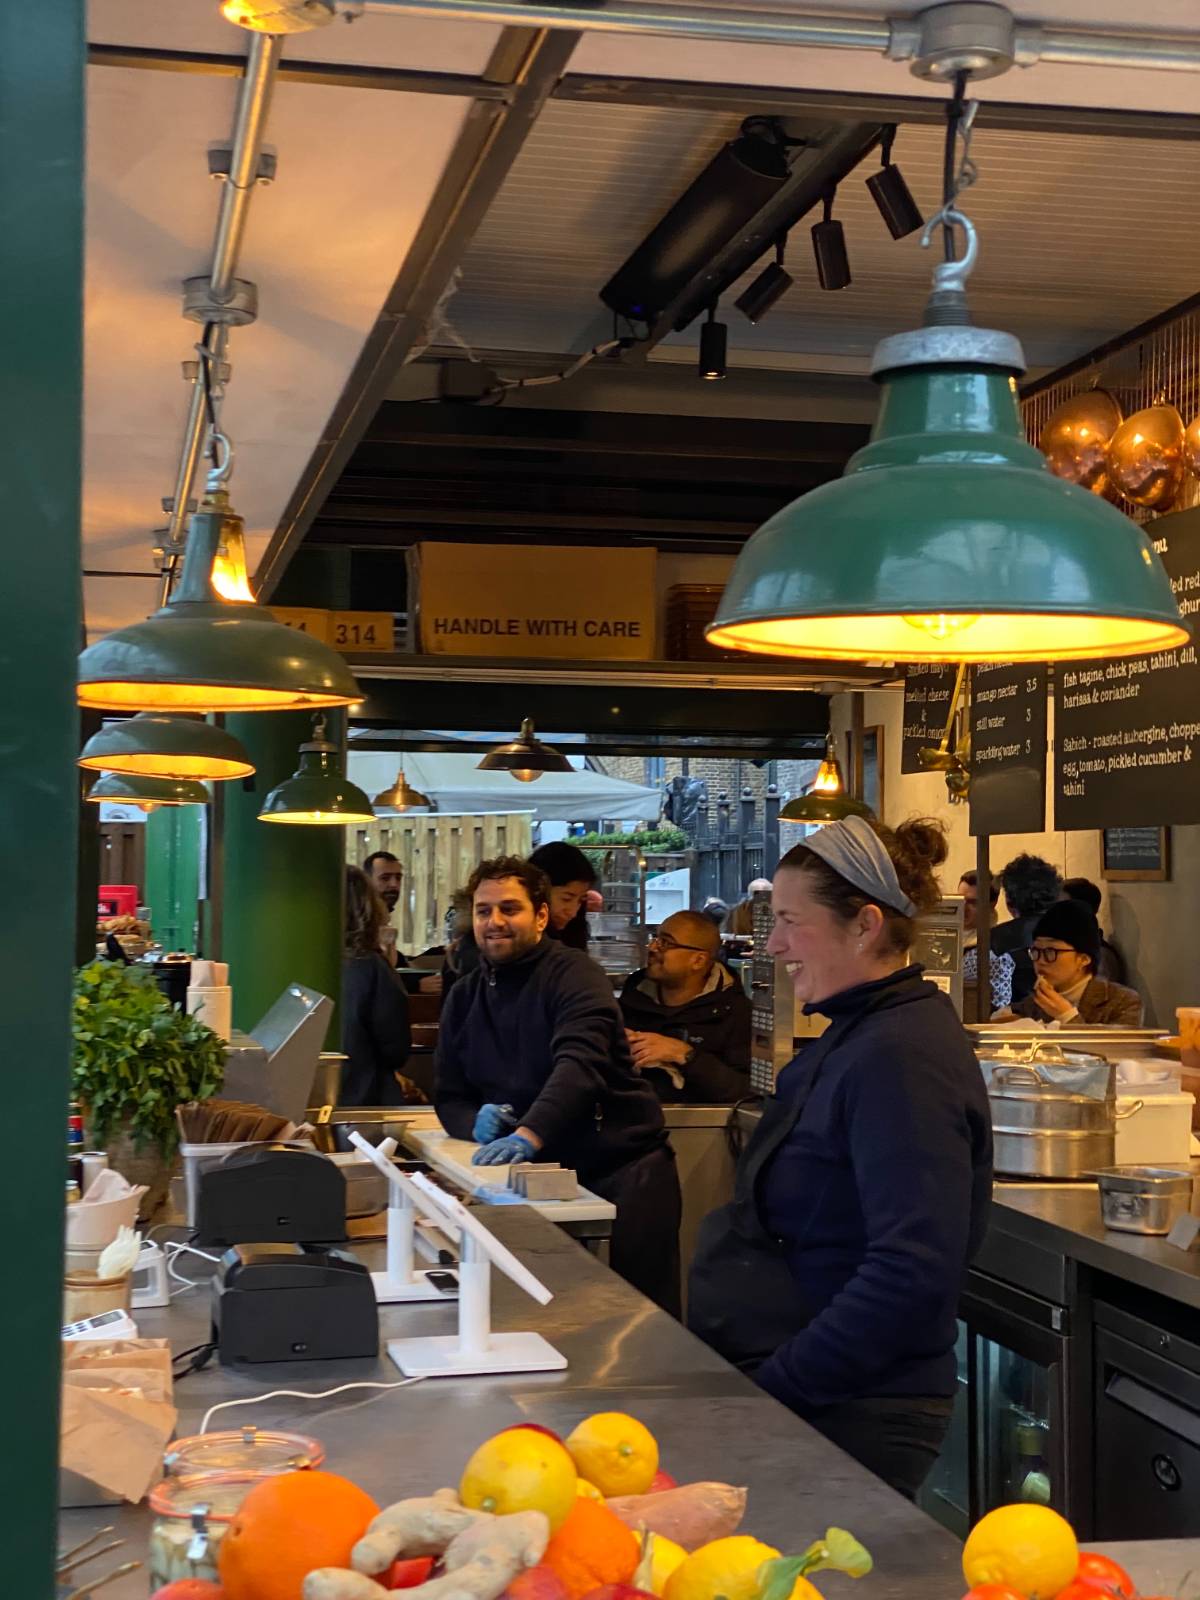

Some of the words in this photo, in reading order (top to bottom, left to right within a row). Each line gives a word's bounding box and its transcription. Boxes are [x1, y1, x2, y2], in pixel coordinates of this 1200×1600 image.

[1151, 538, 1168, 554] nu
[1177, 598, 1200, 619] ghur
[336, 623, 377, 645] 314
[434, 618, 521, 635] HANDLE
[527, 619, 577, 636] WITH
[584, 620, 641, 637] CARE
[1063, 672, 1077, 688] fish
[1079, 669, 1105, 687] tagine,
[1106, 661, 1127, 680] chick
[1128, 660, 1150, 678] peas,
[1151, 651, 1179, 670] tahini,
[1181, 645, 1198, 665] dill,
[976, 689, 997, 702] mango
[998, 684, 1018, 699] nectar
[1026, 678, 1037, 693] 3.5
[1063, 692, 1091, 709] harissa
[1092, 686, 1099, 703] &
[1100, 683, 1140, 702] coriander
[988, 716, 1006, 728] water
[1025, 708, 1032, 722] 3
[1025, 740, 1031, 754] 3
[1063, 735, 1087, 752] Sabich
[1093, 731, 1122, 748] roasted
[1123, 726, 1169, 745] aubergine,
[1079, 760, 1107, 773] tomato,
[1108, 752, 1137, 773] pickled
[1138, 748, 1182, 766] cucumber
[1183, 745, 1192, 762] &
[1063, 779, 1085, 796] tahini
